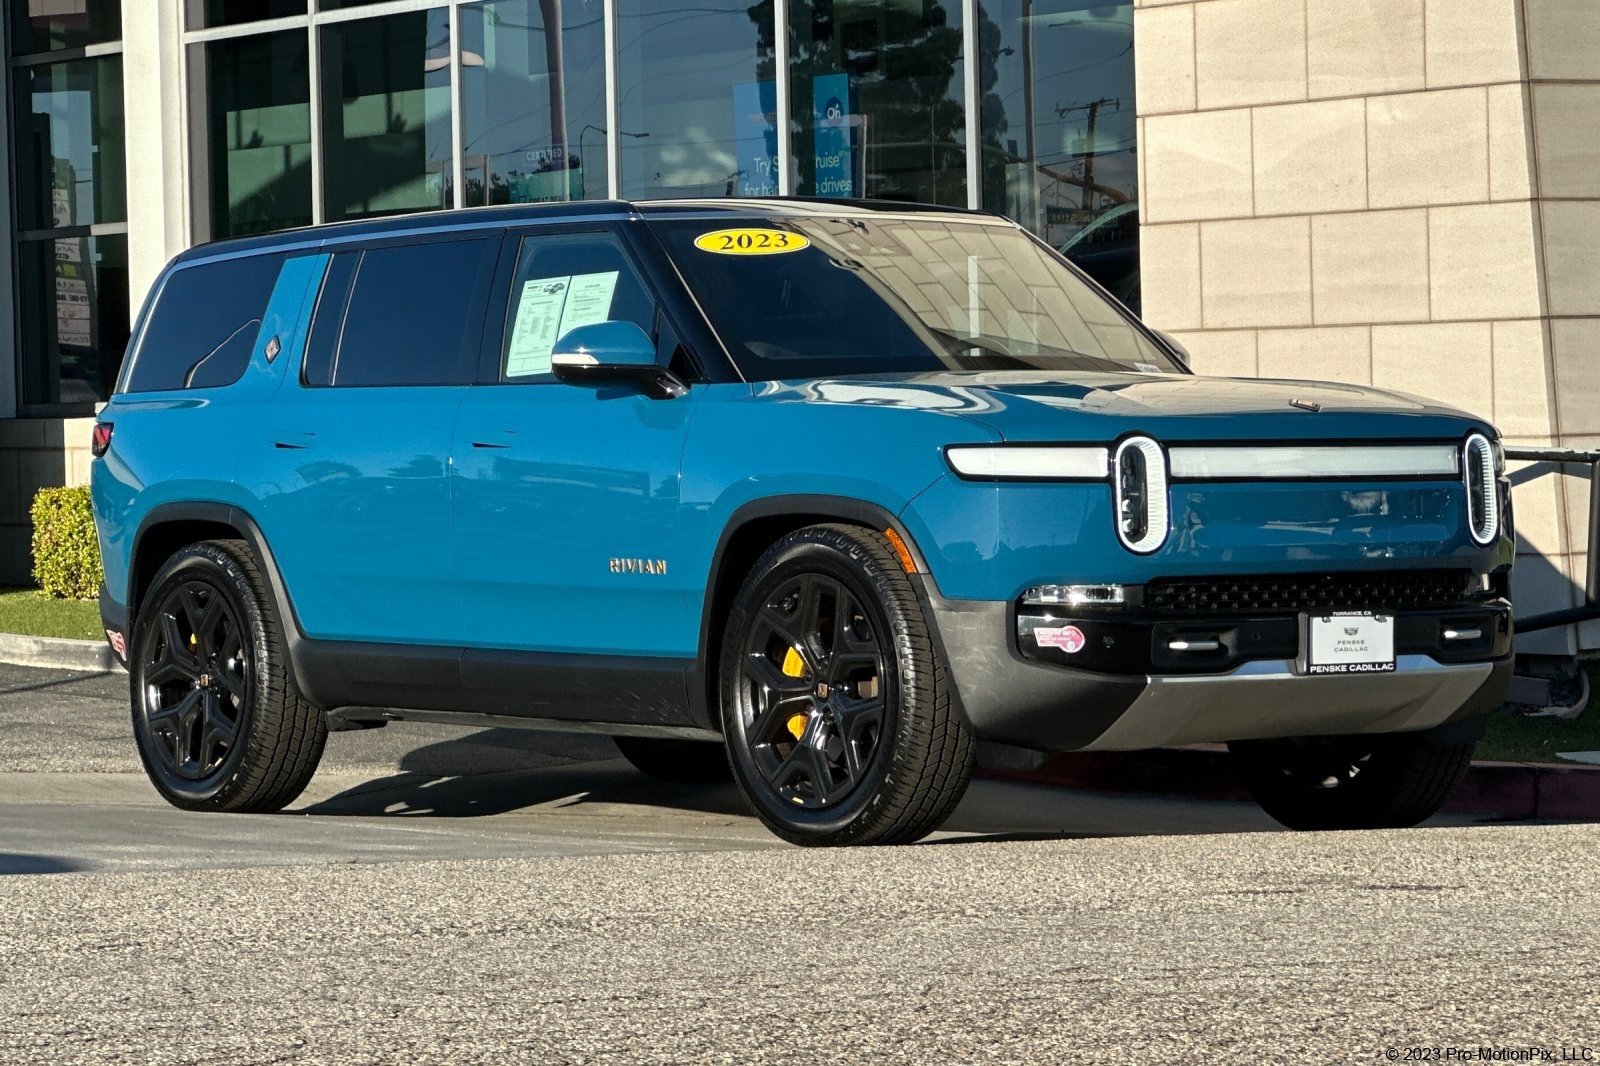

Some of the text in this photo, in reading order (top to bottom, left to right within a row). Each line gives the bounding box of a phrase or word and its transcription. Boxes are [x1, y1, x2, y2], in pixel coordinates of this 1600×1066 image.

[753, 157, 770, 176] Try
[815, 152, 840, 169] ruise
[744, 182, 761, 196] for
[821, 177, 852, 193] drives
[718, 233, 789, 251] 2023
[608, 557, 667, 575] RIVIAN
[1310, 663, 1394, 673] PENSKE CADILLAC
